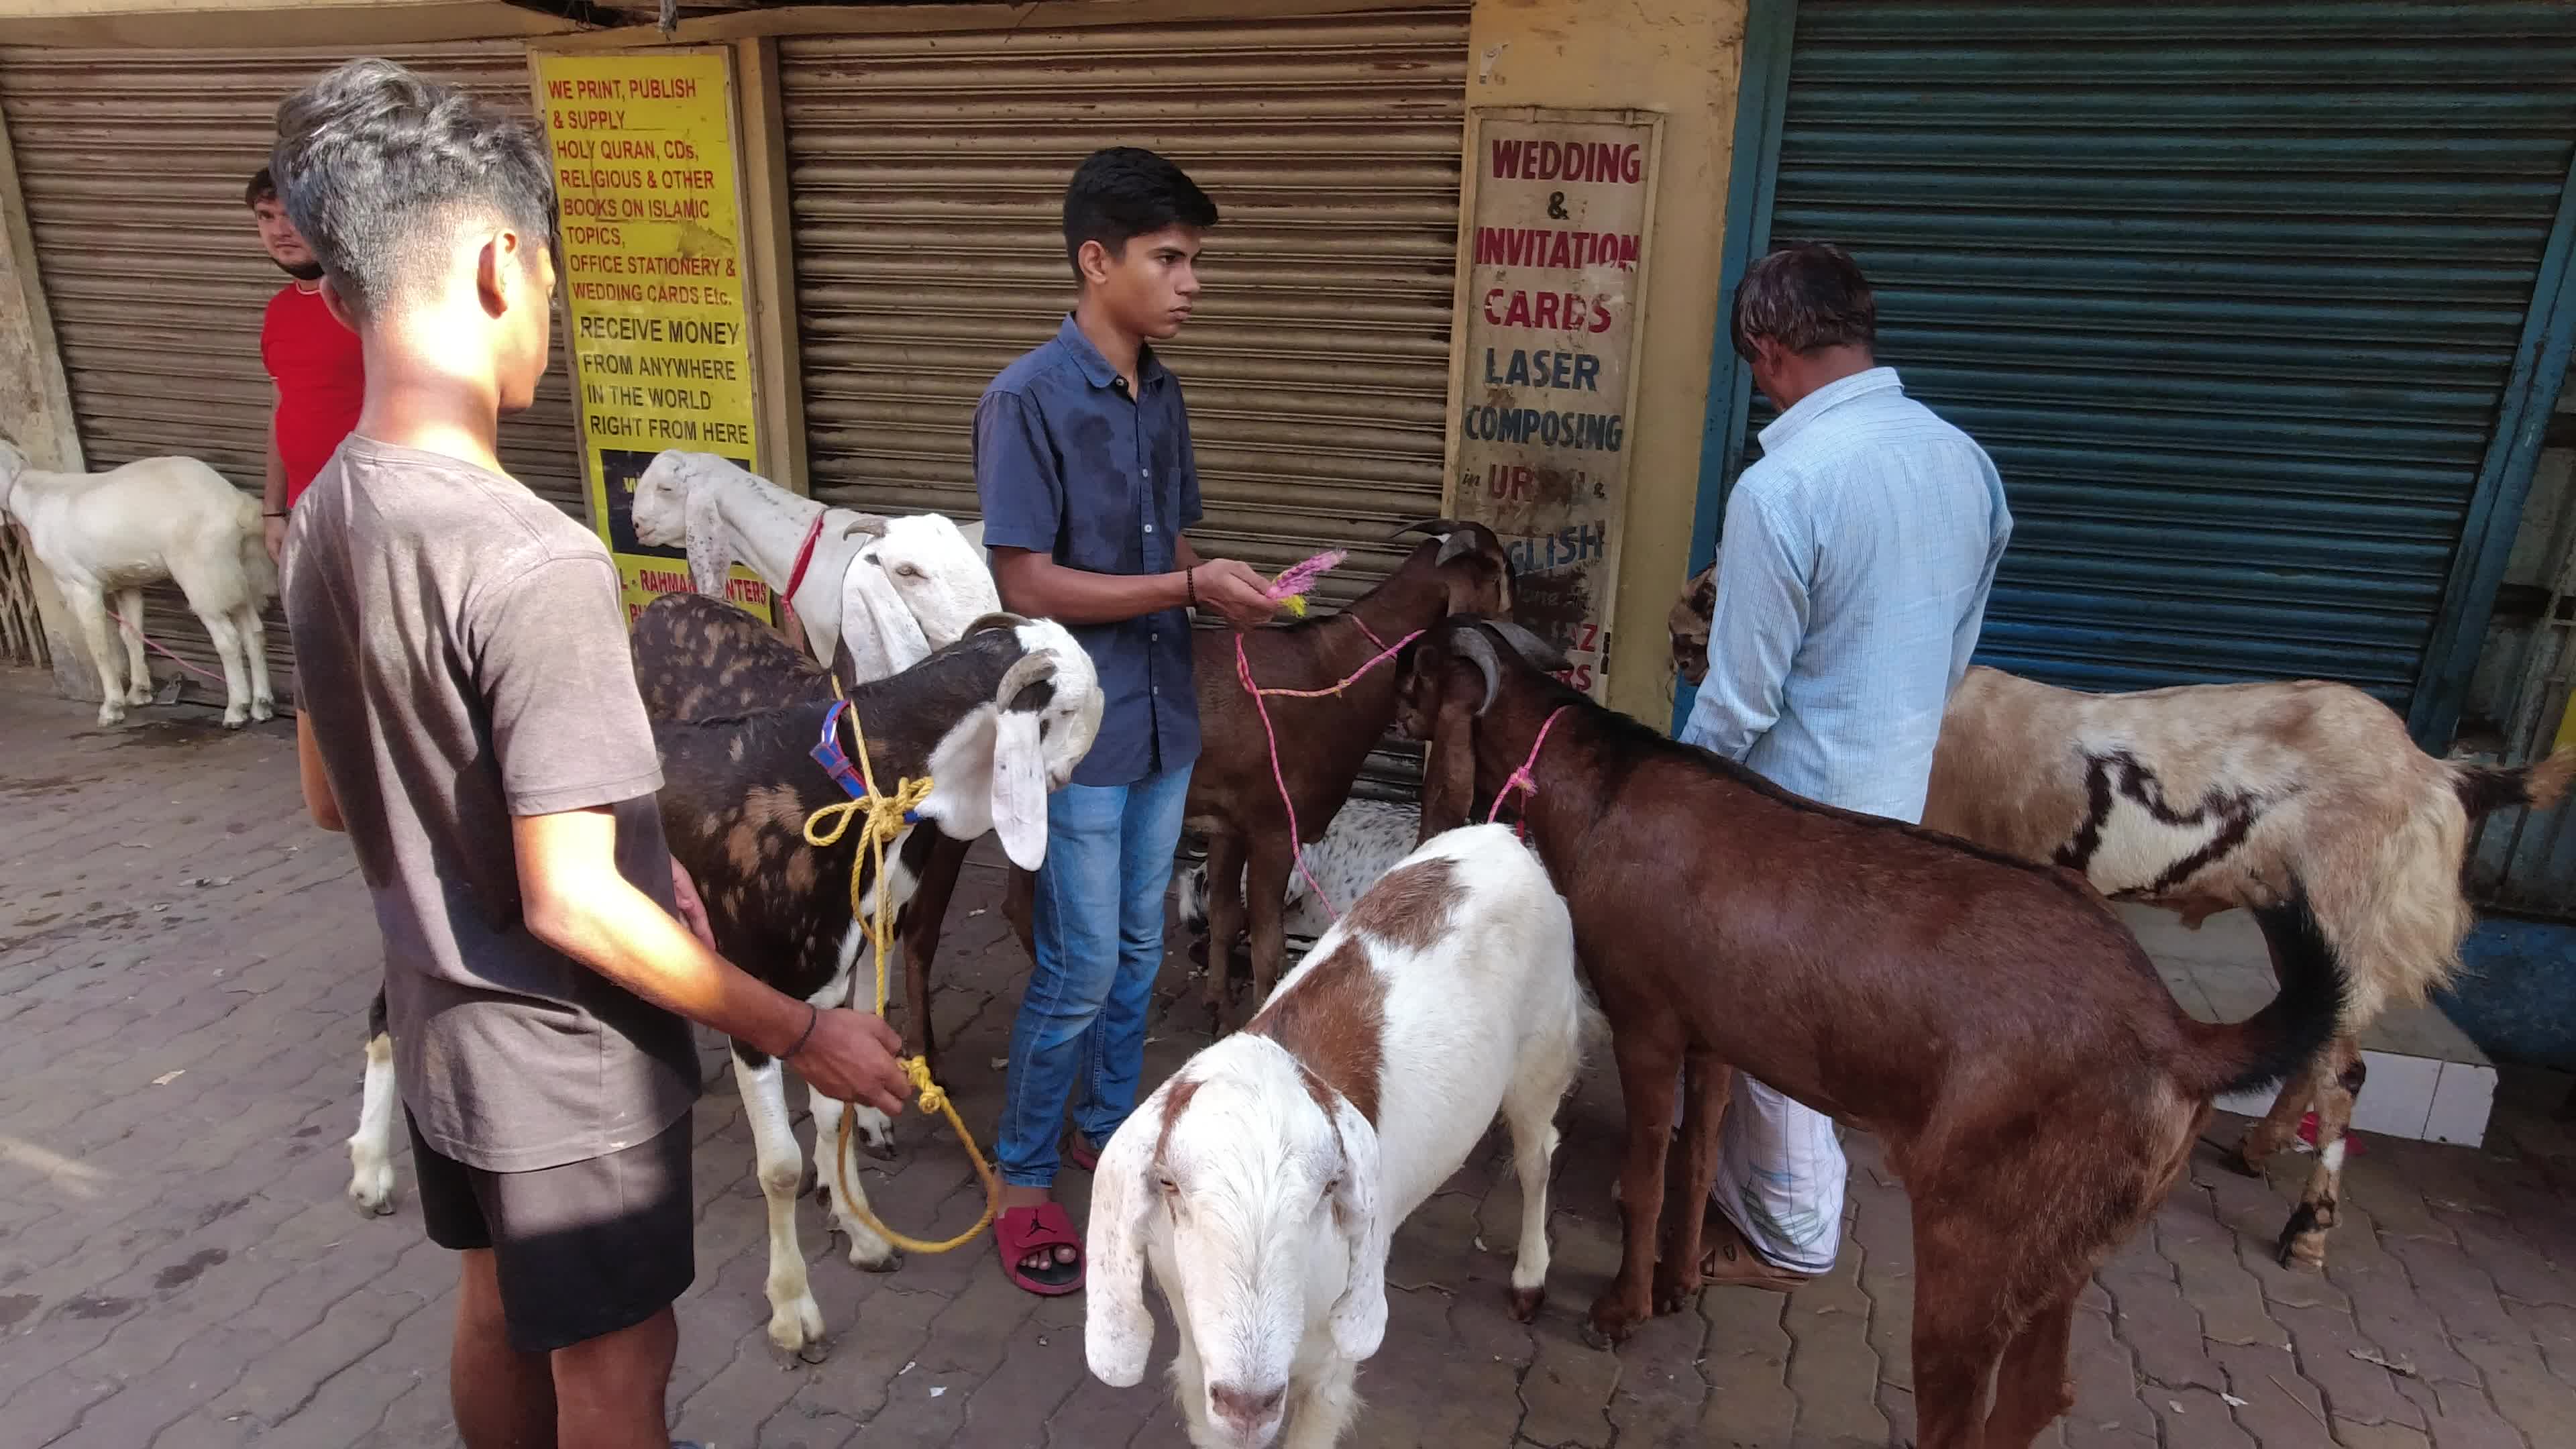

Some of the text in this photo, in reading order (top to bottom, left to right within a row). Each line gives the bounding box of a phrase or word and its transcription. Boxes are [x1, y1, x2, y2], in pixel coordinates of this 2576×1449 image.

[547, 78, 696, 102] WE PRINT, PUBLISH
[553, 110, 625, 129] & SUPPLY
[556, 140, 698, 163] HOLY QURAN, CDs,
[1492, 139, 1641, 184] WEDDING
[561, 169, 714, 189] RELIGIOUS & OTHER
[564, 198, 709, 219] BOOKS ON ISLAMIC
[1547, 191, 1570, 220] &
[1475, 226, 1640, 272] INVITATION
[570, 254, 736, 276] OFFICE STATIONERY &
[573, 282, 642, 301] WEDDING
[647, 286, 699, 304] CARDS
[1485, 288, 1611, 333] CARDS
[580, 316, 739, 345] RECEIVE MONEY
[583, 354, 736, 381] FROM ANYWHERE
[1485, 347, 1600, 392] LASER
[587, 384, 711, 411] IN THE WORLD
[590, 415, 749, 445] RIGHT FROM HERE
[1464, 405, 1623, 452] COMPOSING
[1509, 519, 1605, 571] GLISH
[725, 579, 766, 604] NTERS
